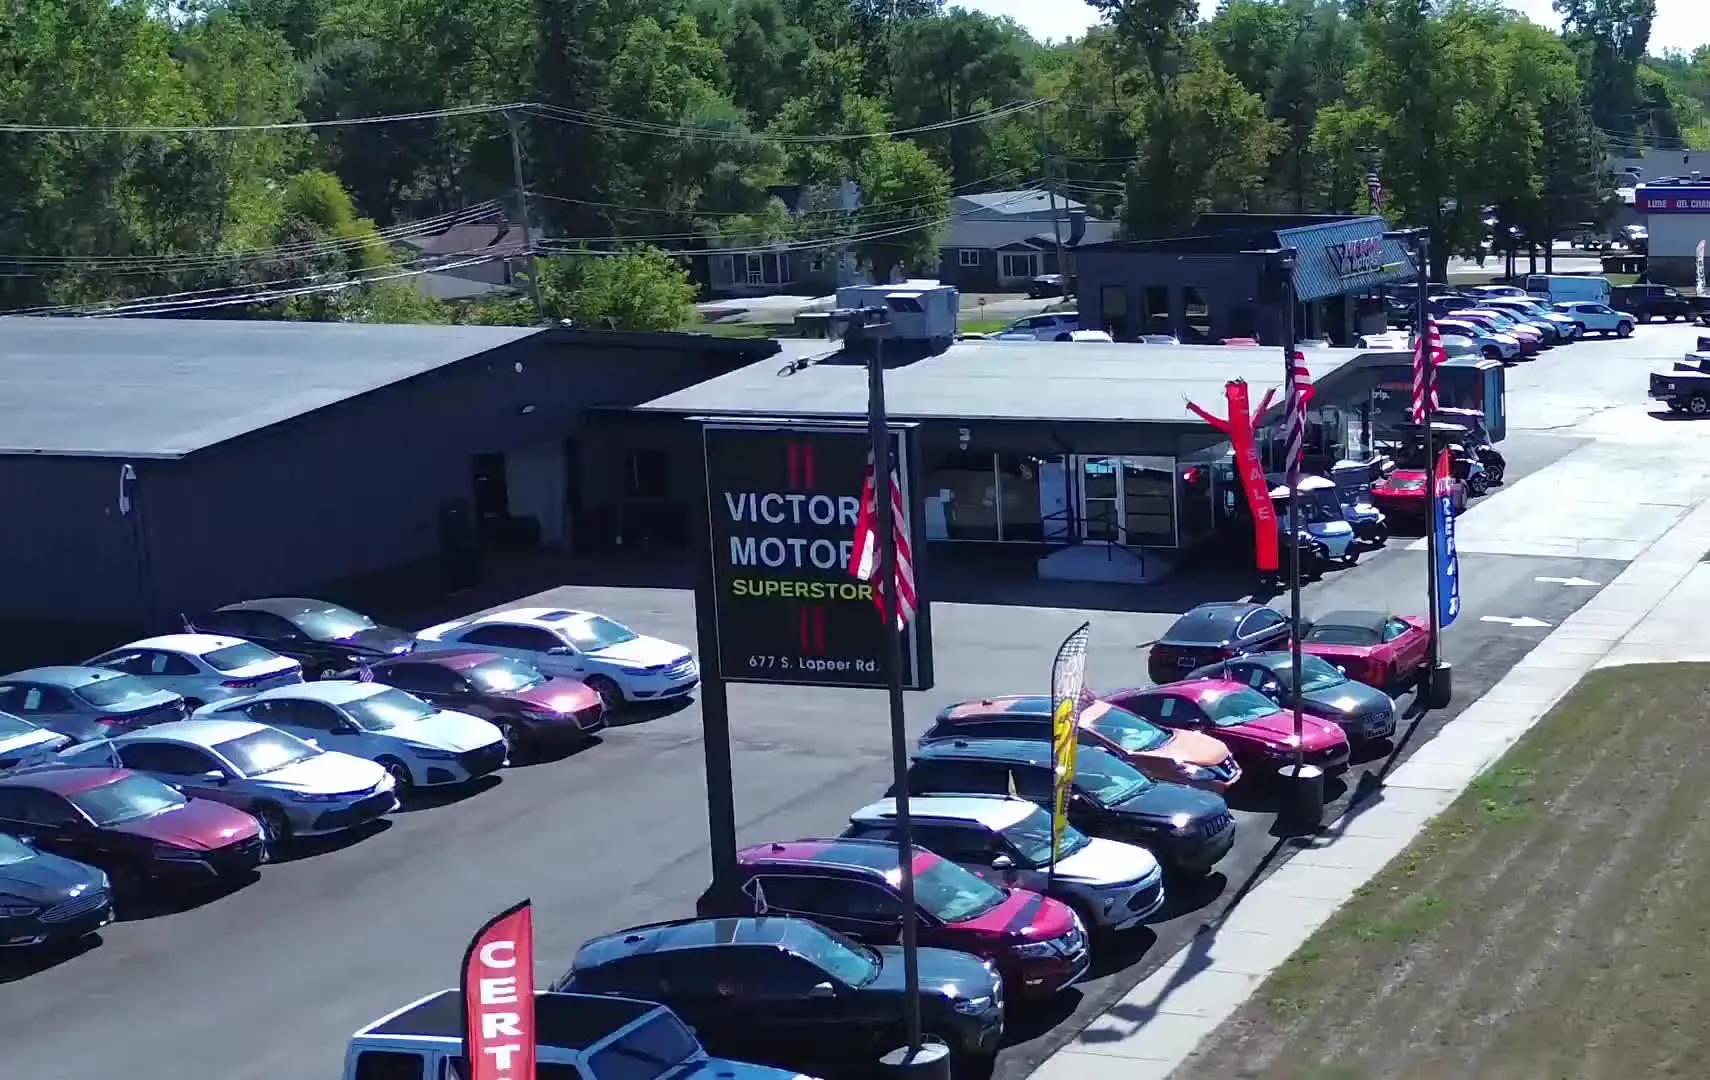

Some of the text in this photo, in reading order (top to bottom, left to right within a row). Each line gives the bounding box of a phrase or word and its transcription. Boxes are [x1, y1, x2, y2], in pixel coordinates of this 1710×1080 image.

[1676, 200, 1689, 208] OIL
[1246, 447, 1273, 521] SALE
[724, 491, 862, 526] VICTOR
[730, 535, 854, 569] MOTO
[732, 579, 873, 601] SUPERSTOR
[749, 656, 881, 672] 677 S. Lapeer Rd.
[479, 940, 524, 1080] CERT
